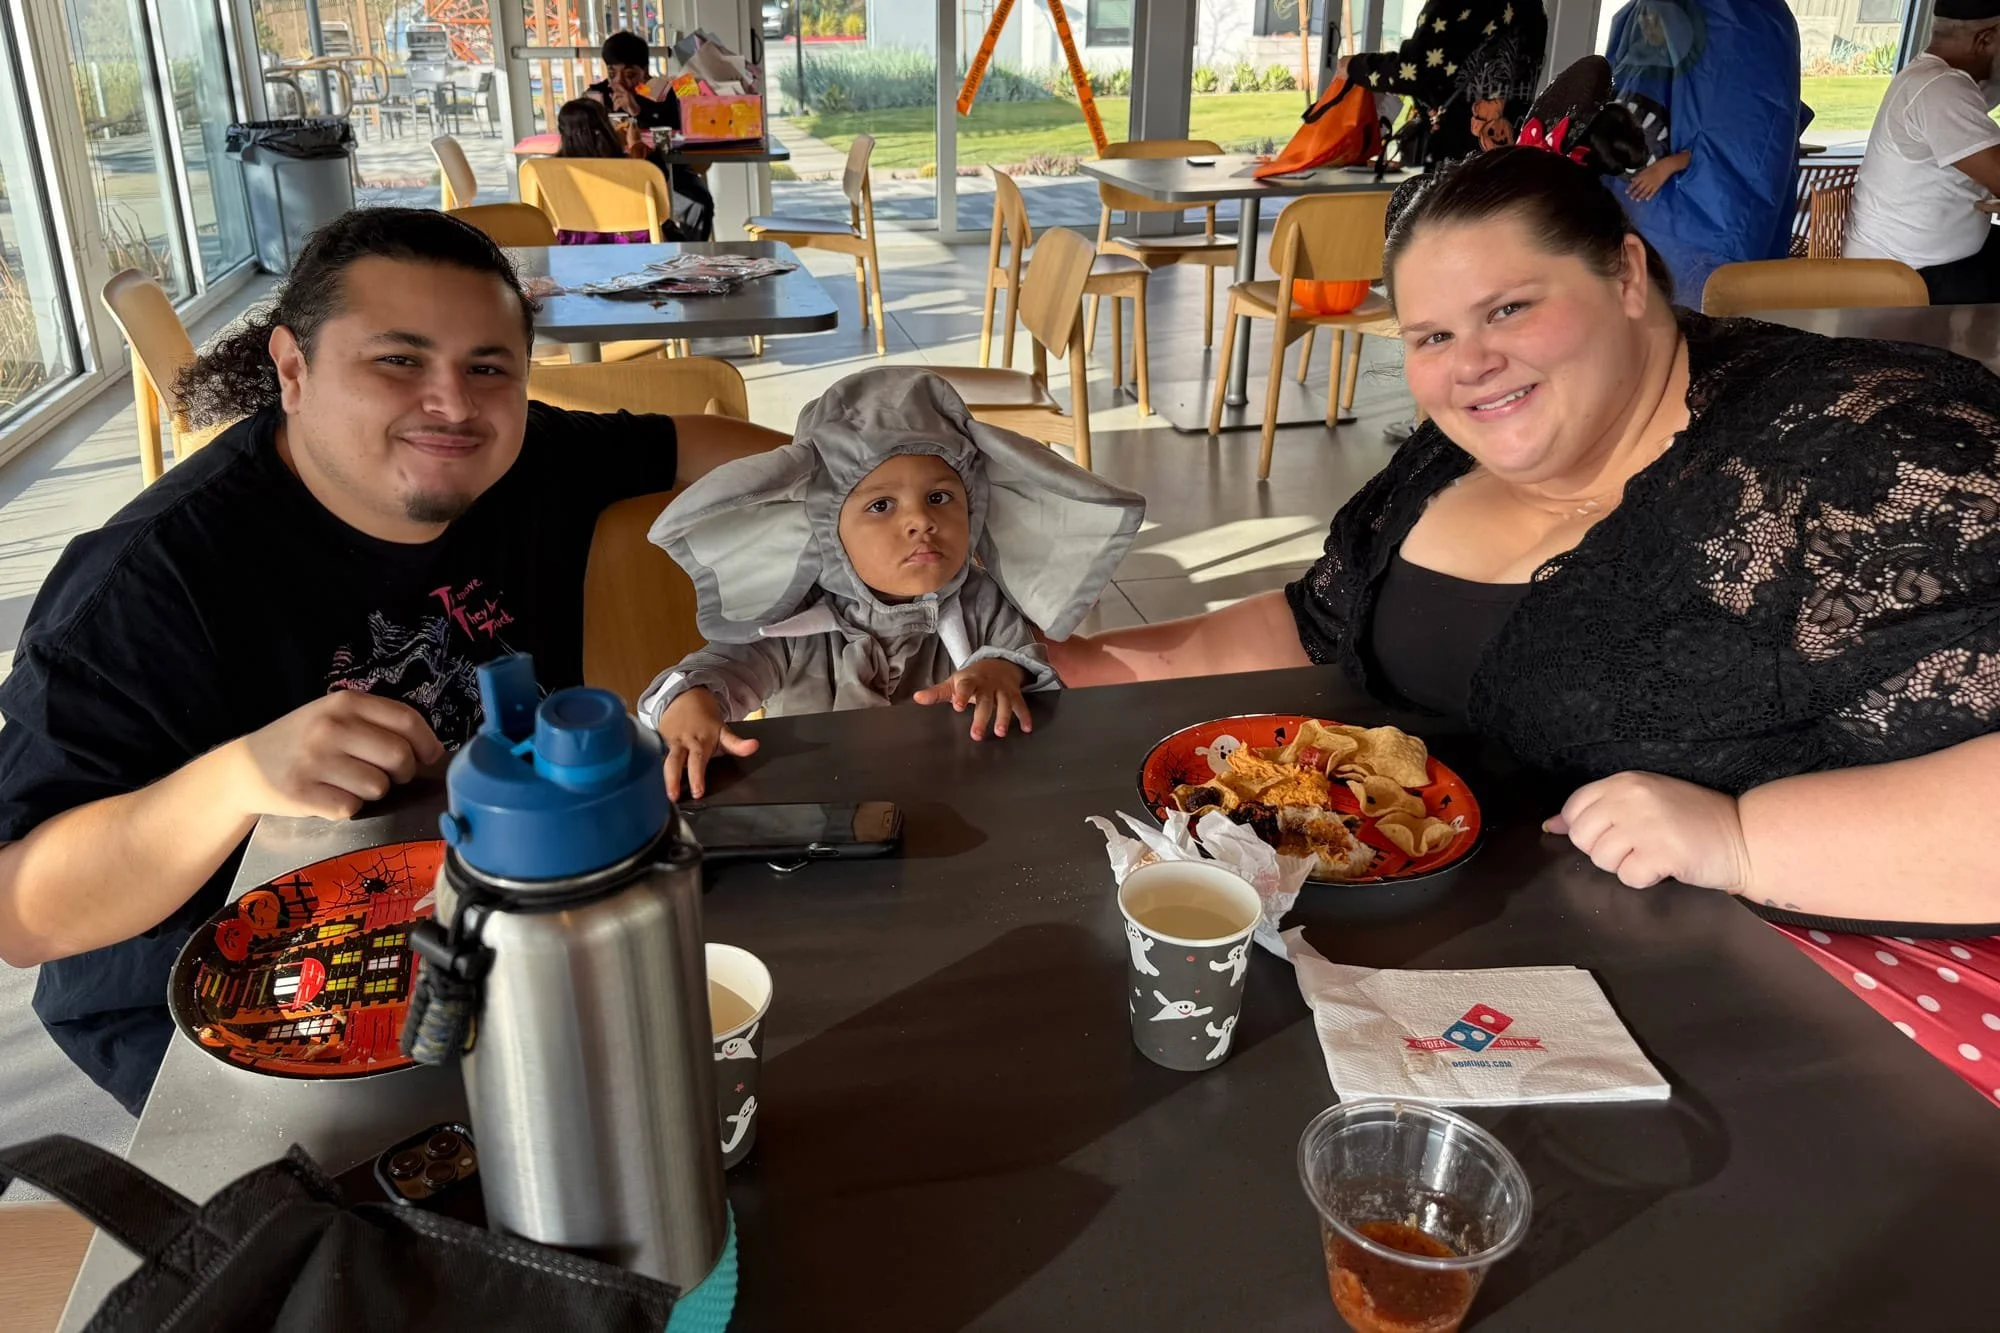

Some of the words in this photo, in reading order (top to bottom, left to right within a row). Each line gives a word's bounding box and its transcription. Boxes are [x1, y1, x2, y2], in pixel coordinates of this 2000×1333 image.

[1415, 1039, 1447, 1049] ORDER
[1500, 1039, 1533, 1048] ONLINE
[1451, 1060, 1513, 1068] DOMINOS.COM
